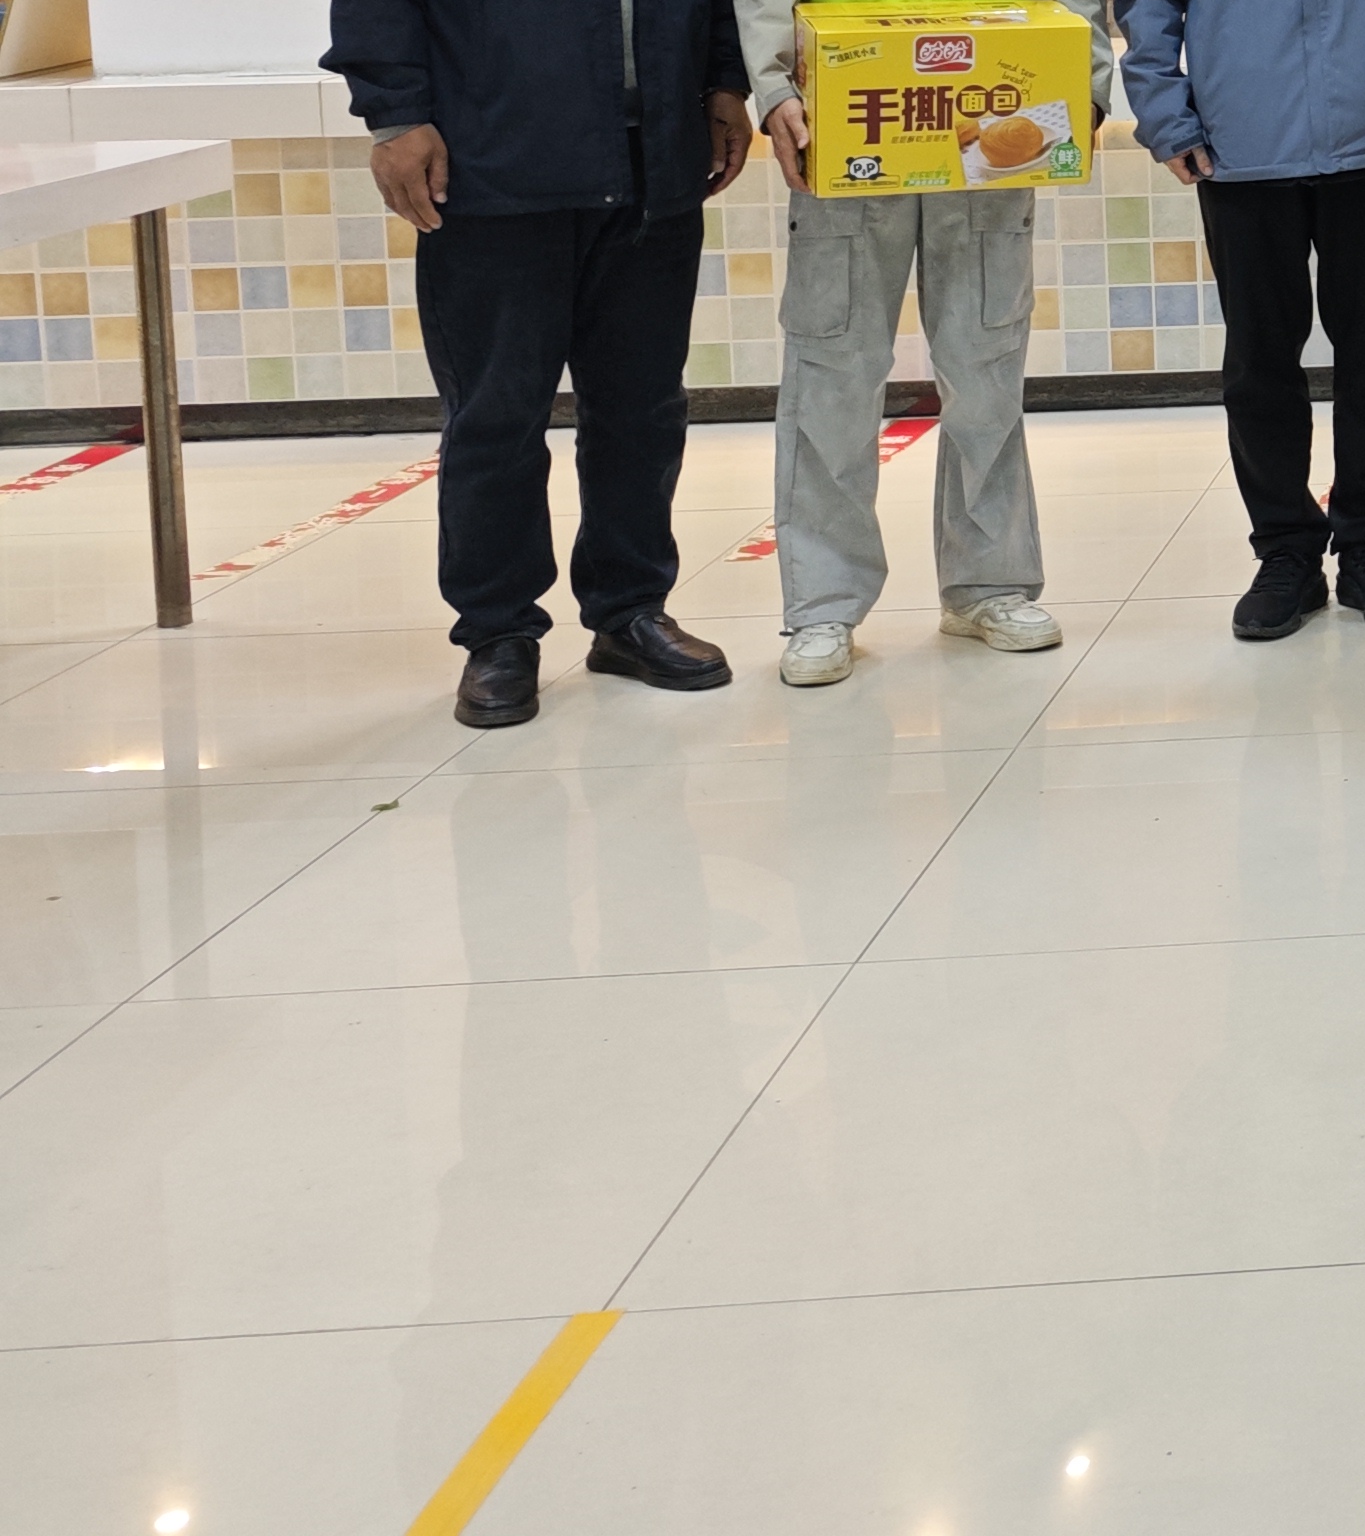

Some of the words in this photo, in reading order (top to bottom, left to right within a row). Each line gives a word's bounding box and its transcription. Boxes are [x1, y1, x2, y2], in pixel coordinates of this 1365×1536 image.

[917, 40, 969, 64] 盼盼
[847, 85, 1019, 145] 手撕面包
